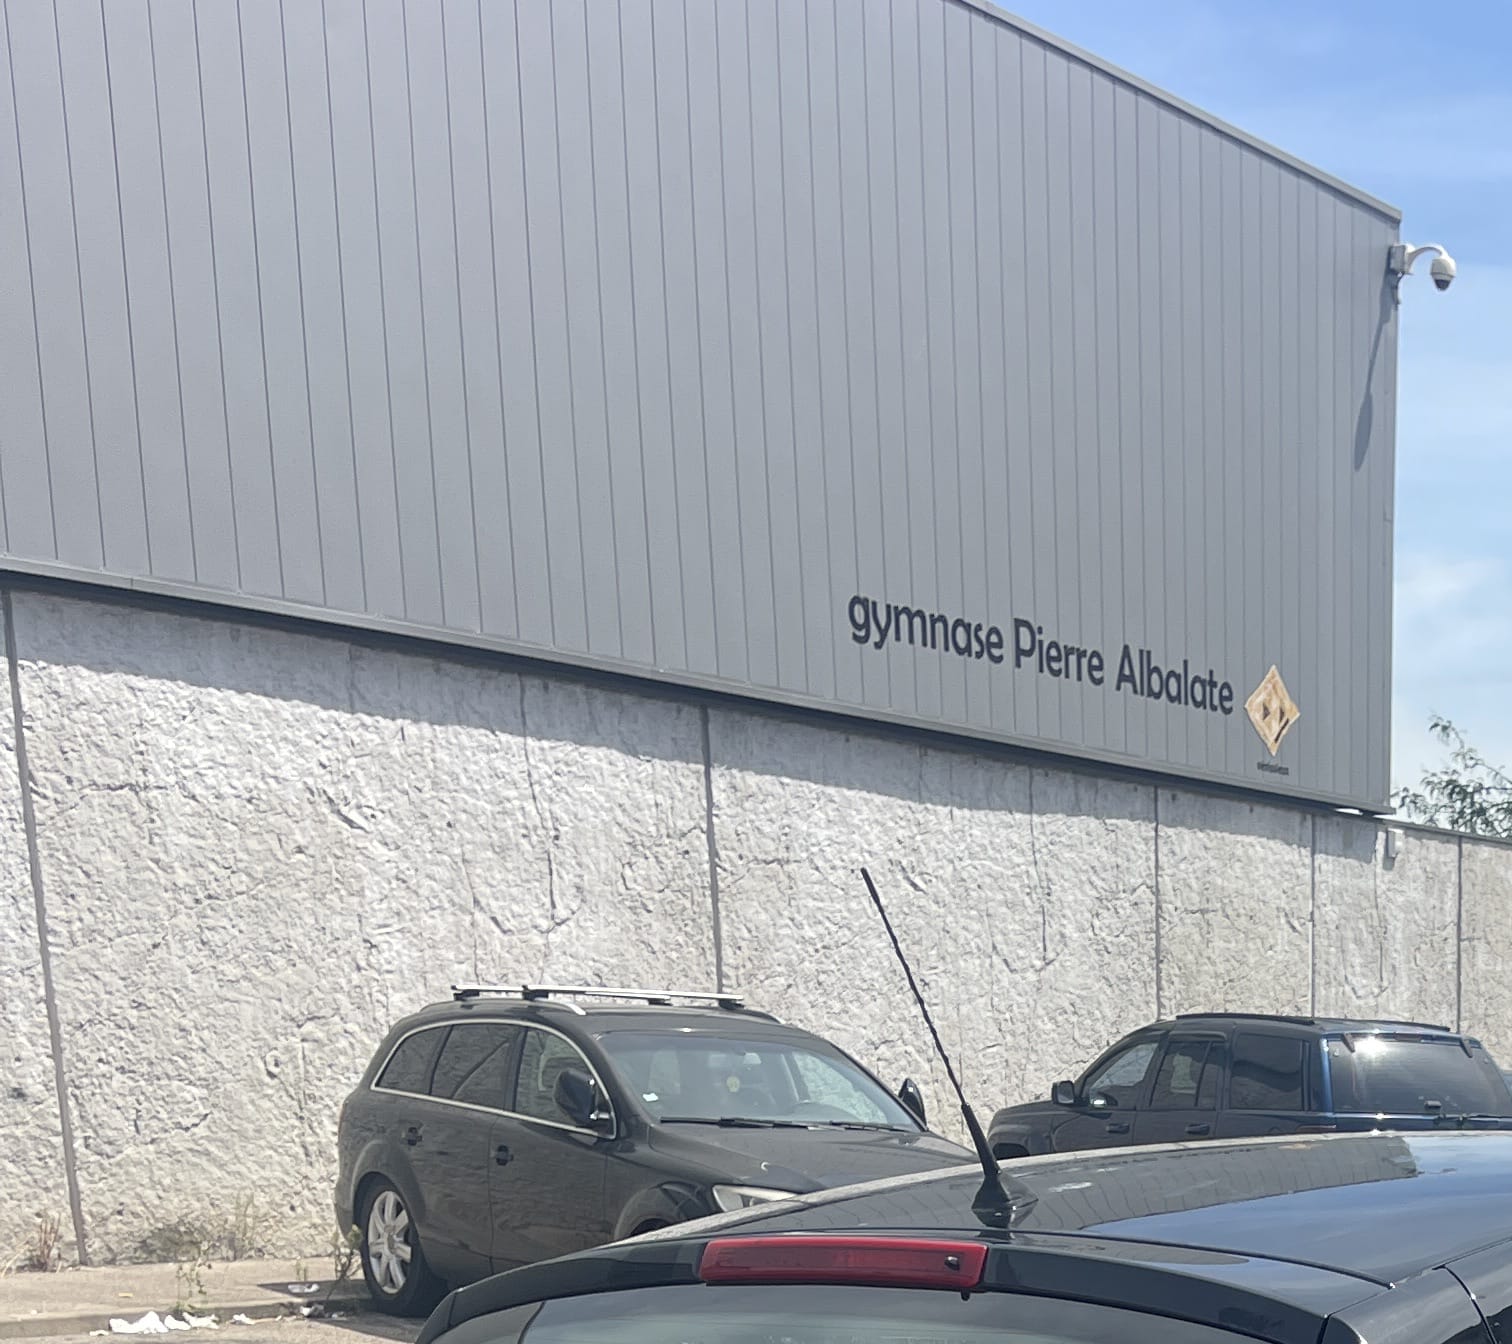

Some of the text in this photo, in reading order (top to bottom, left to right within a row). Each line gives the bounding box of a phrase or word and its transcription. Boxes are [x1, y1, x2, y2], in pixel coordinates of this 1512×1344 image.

[848, 595, 1234, 715] gymnase Pierre Albalate
